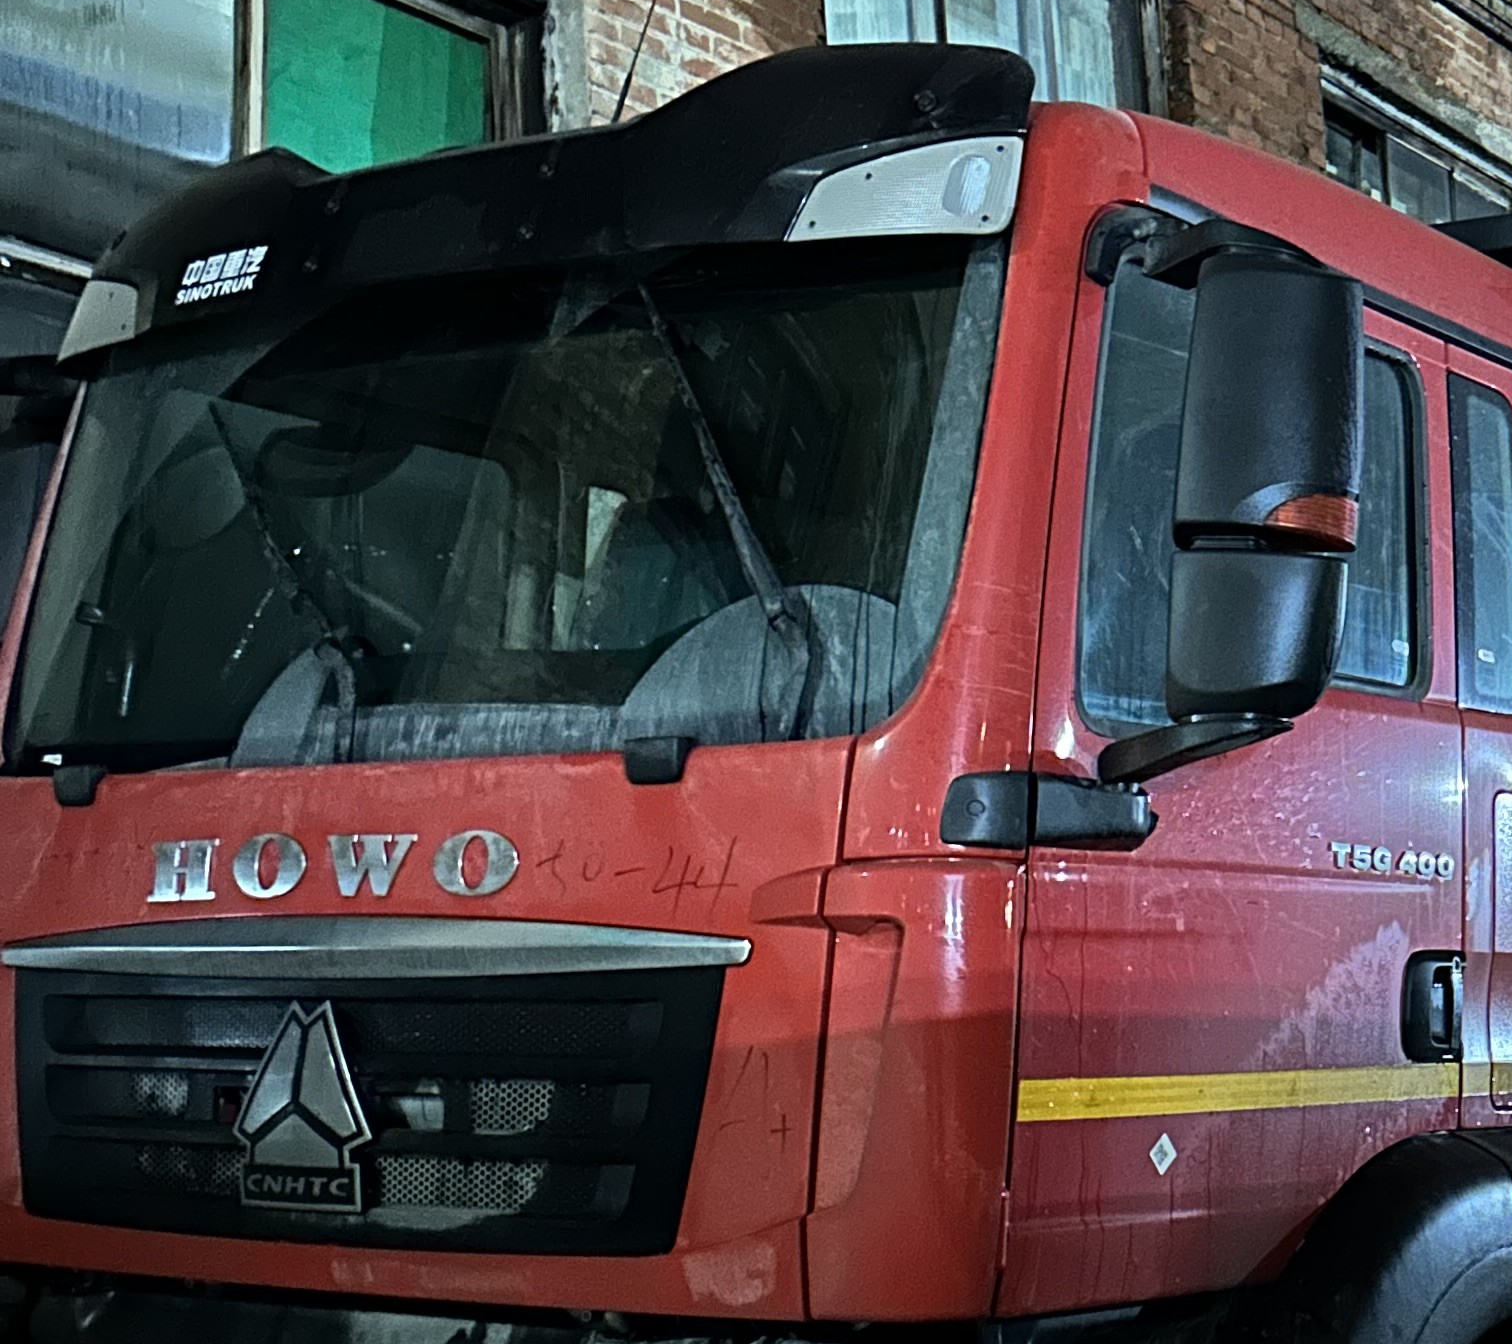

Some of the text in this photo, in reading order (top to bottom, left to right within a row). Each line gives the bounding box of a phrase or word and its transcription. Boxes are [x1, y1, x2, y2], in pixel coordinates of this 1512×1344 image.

[175, 274, 257, 306] SINOTRUK
[147, 829, 519, 902] HOWO
[1328, 841, 1455, 881] T5G 400
[246, 1173, 350, 1196] CNHTC
